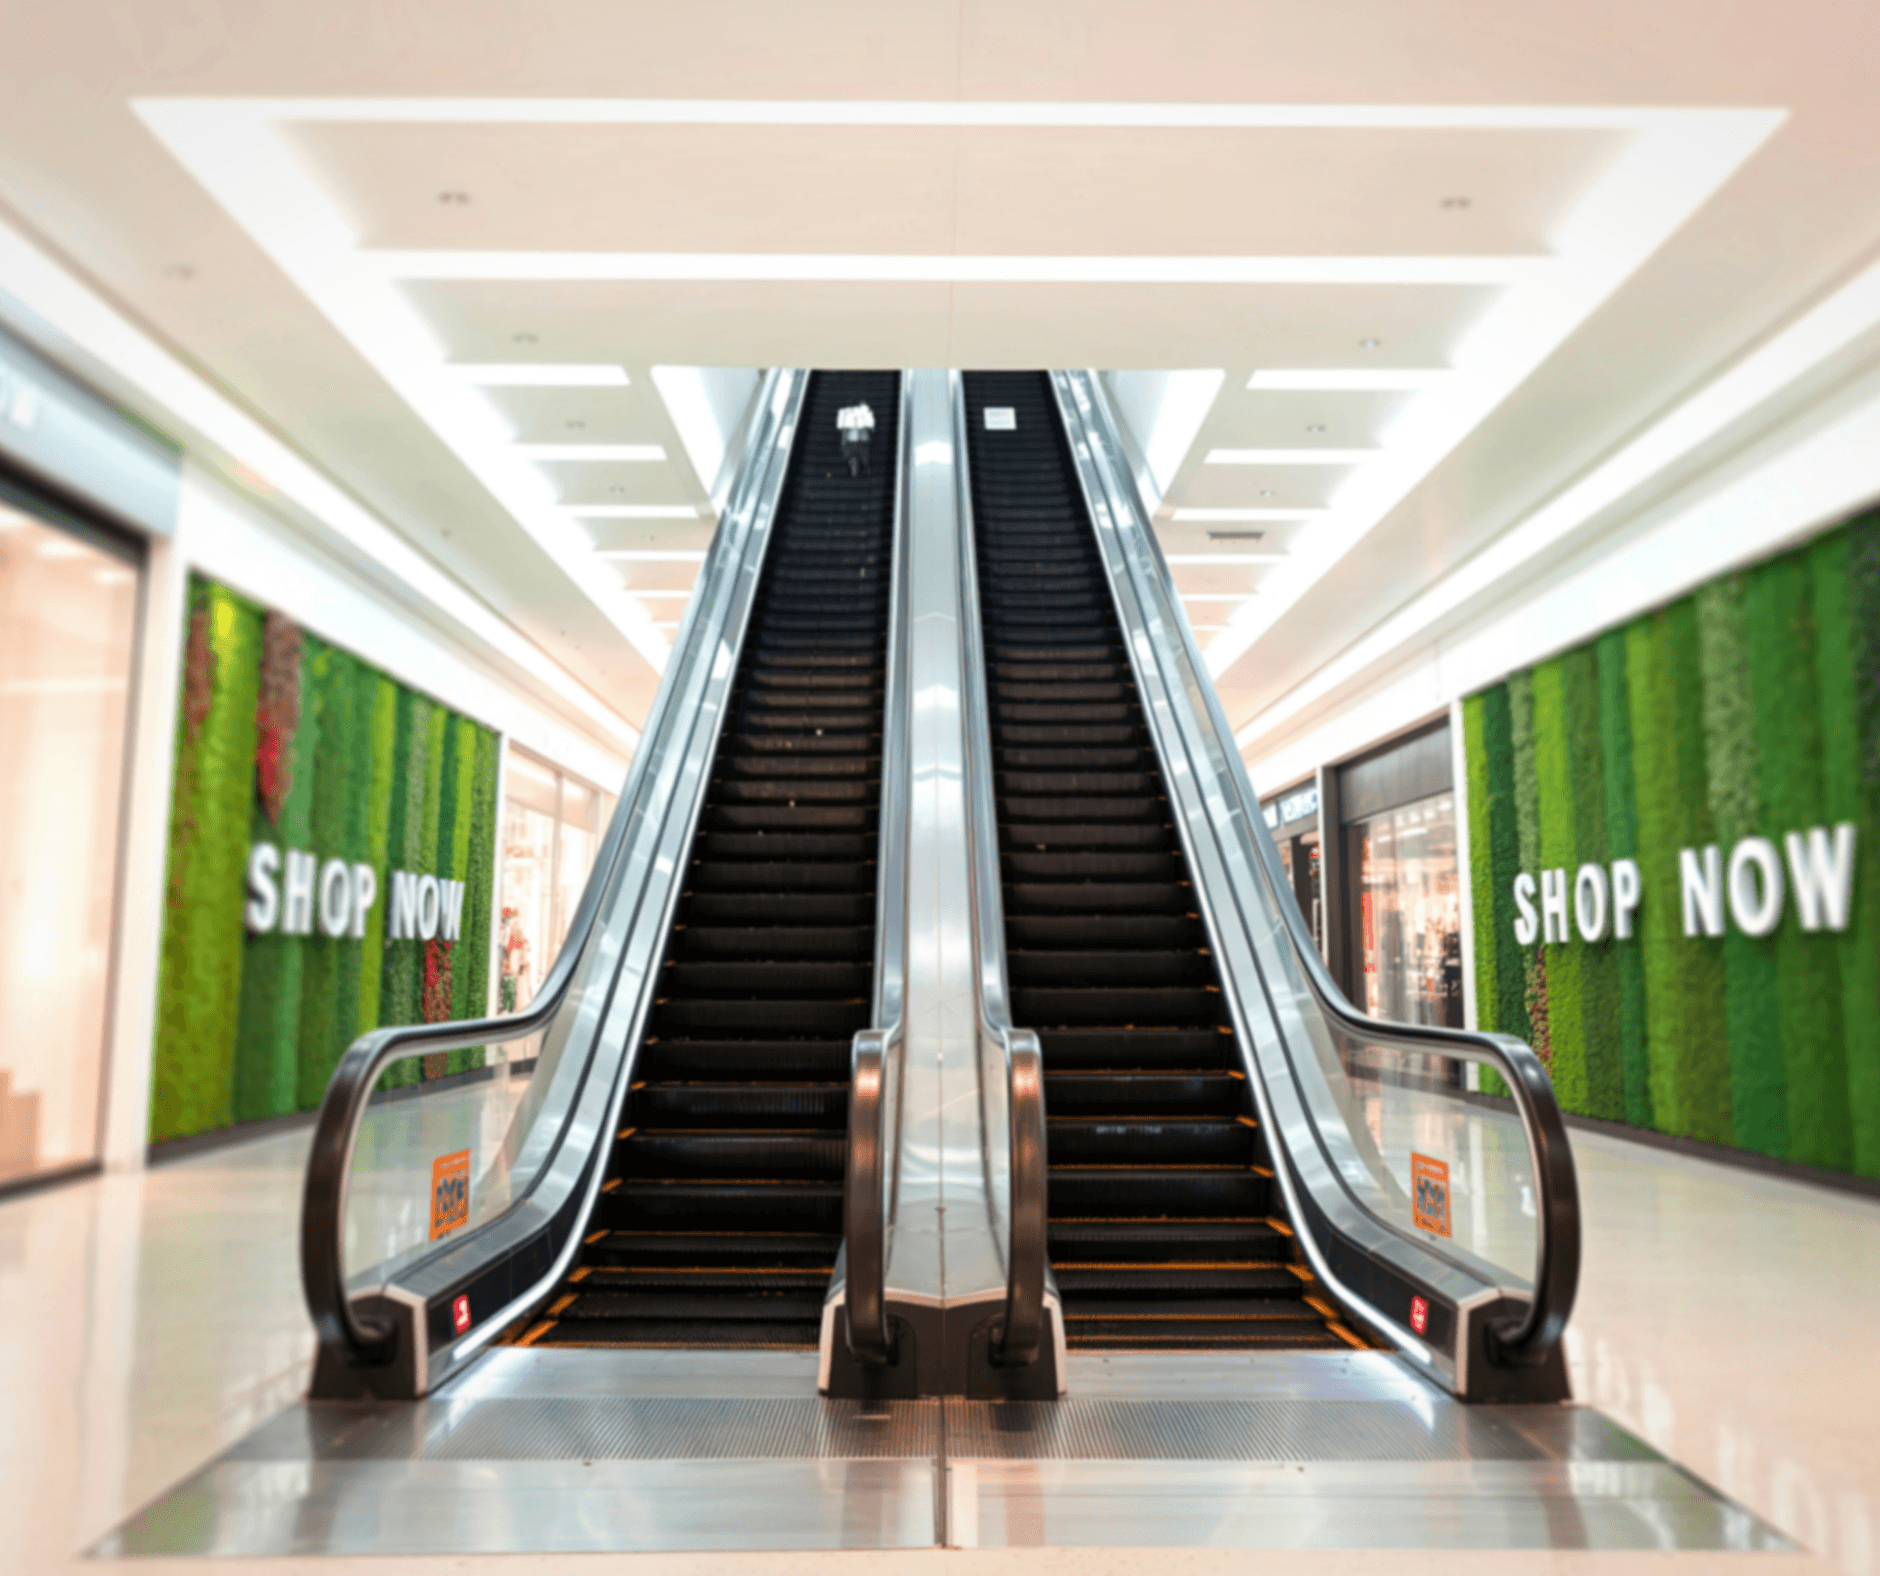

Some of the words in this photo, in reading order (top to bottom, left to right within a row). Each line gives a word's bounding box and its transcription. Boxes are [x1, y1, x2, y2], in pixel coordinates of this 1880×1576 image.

[247, 842, 377, 938] SHOP
[388, 869, 464, 942] NOW
[1513, 857, 1641, 945] SHOP
[1679, 821, 1857, 936] NOW
